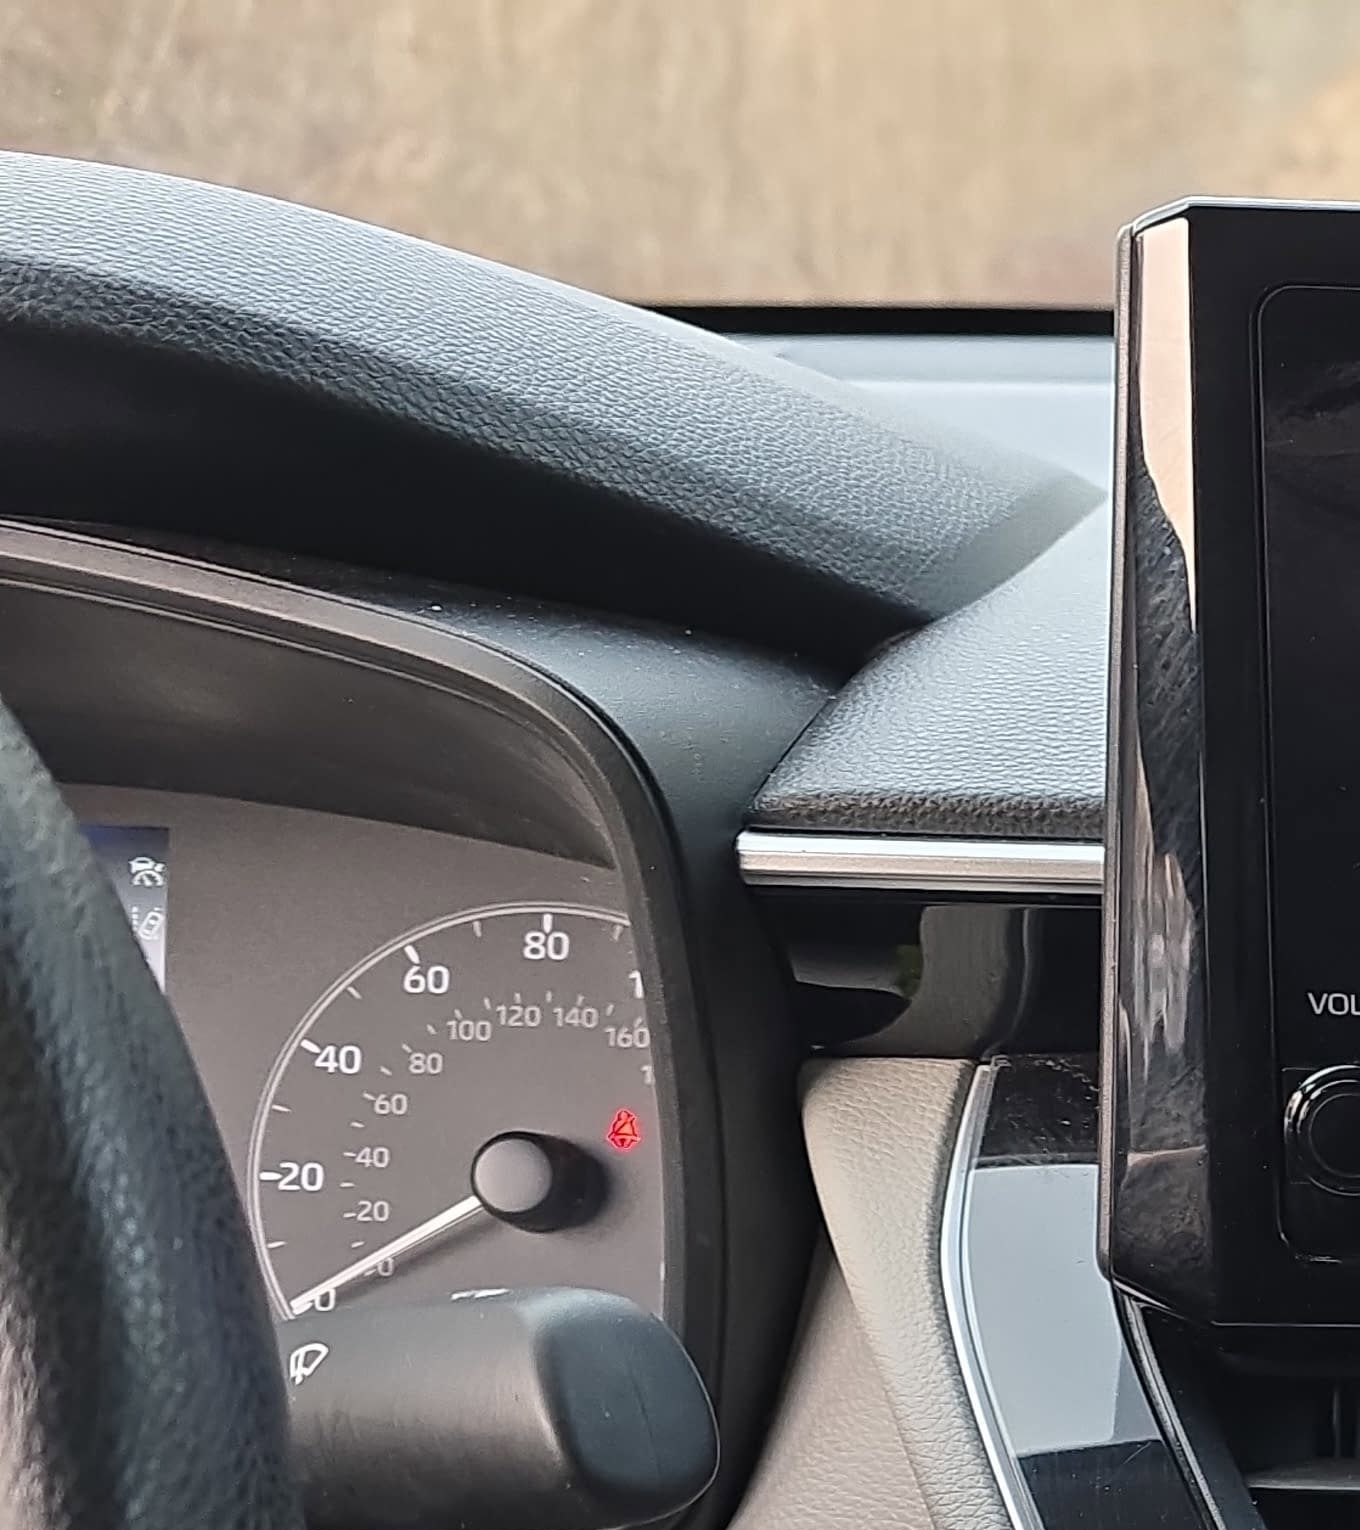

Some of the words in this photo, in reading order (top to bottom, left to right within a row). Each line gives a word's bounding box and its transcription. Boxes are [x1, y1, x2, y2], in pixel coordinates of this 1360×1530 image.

[523, 931, 570, 960] 80
[403, 966, 450, 993] 60
[497, 1004, 542, 1027] 120
[552, 1005, 598, 1029] 140
[447, 1019, 492, 1042] 100
[605, 1026, 650, 1049] 160
[315, 1045, 361, 1073] 40
[409, 1052, 443, 1075] 80
[373, 1093, 408, 1116] 60
[355, 1146, 390, 1168] 40
[279, 1162, 324, 1190] 20
[355, 1200, 390, 1223] 20
